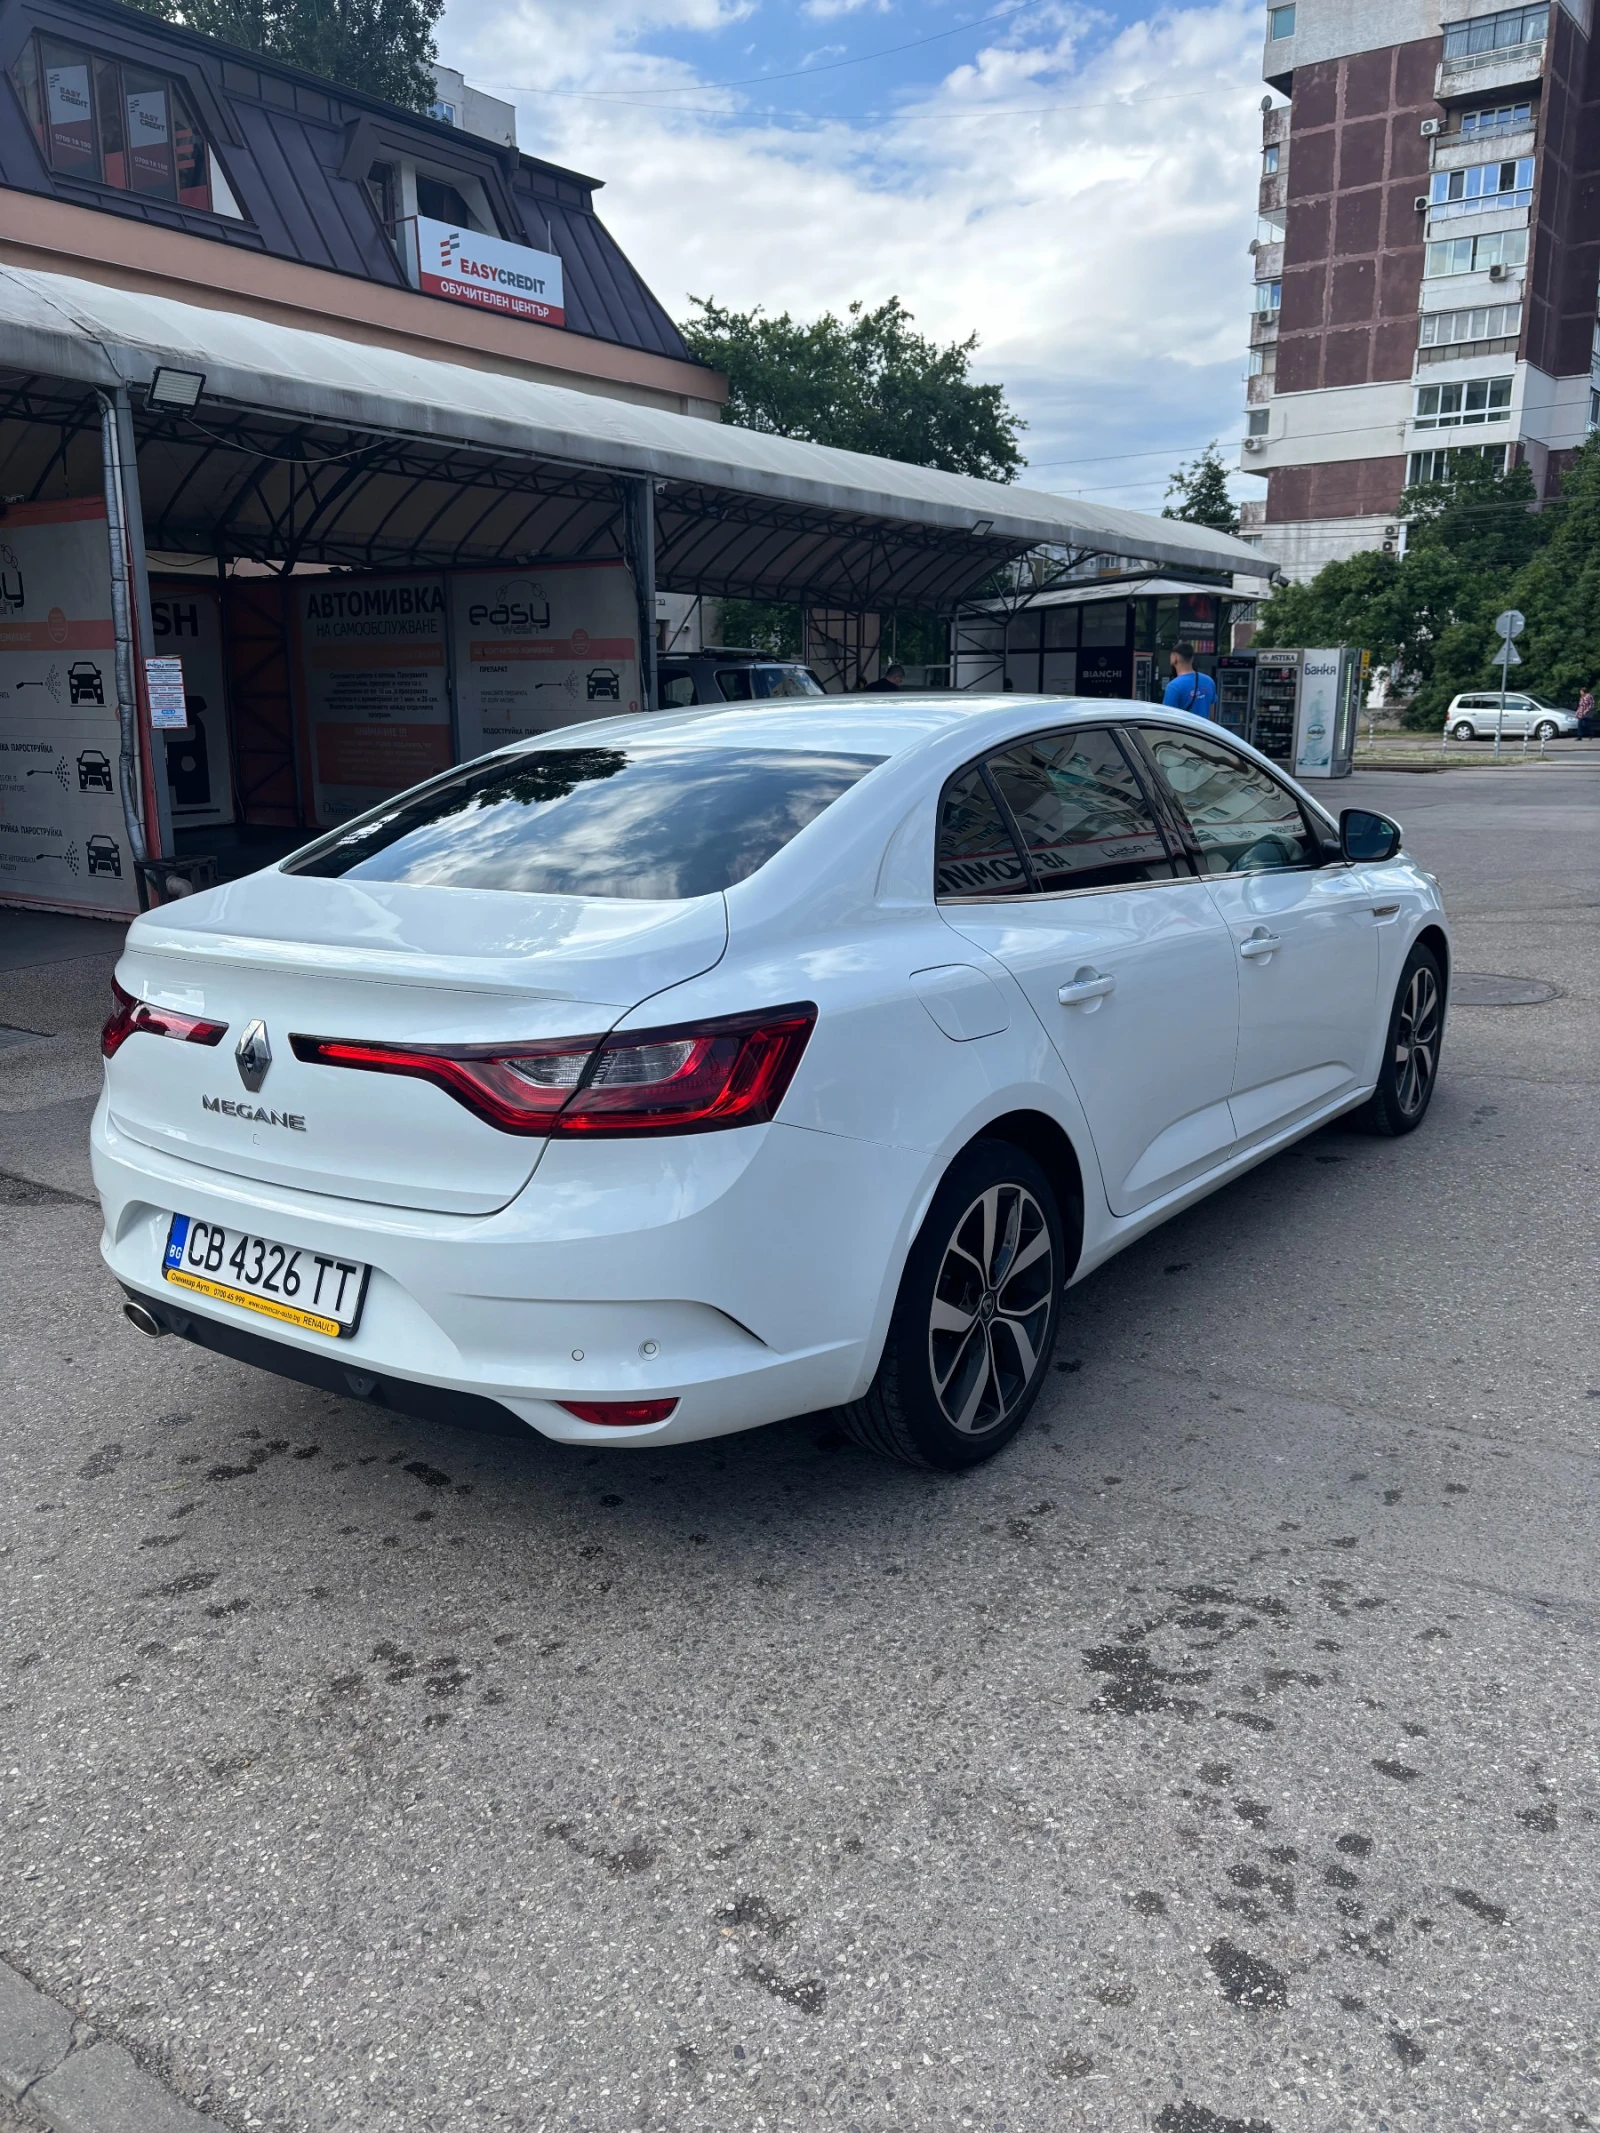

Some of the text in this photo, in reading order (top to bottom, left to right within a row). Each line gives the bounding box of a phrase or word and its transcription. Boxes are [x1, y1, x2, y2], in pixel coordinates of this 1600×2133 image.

[60, 87, 80, 98] EASY
[60, 94, 88, 108] CREDIT
[139, 111, 159, 122] EASY
[140, 118, 165, 132] CREDIT
[55, 133, 71, 143] 0700
[460, 257, 545, 294] EASYCREDIT
[440, 280, 549, 318] ОБУЧИТЕЛЕН ЦЕНТЪР
[307, 585, 446, 619] АВТОМИВКА
[468, 601, 550, 629] easy
[316, 618, 439, 637] НА САМООБСЛУЖВАНЕ
[479, 665, 508, 673] ПРЕПАРАТ
[1082, 670, 1122, 678] BIANCHI
[1304, 662, 1337, 676] Банкя
[483, 726, 523, 736] ВОДОСТРУЙКА
[11, 742, 53, 754] ПАРОСТРУЙКА
[21, 826, 63, 838] ПАРОСТРУЙКА
[202, 1094, 307, 1132] MEGANE
[169, 1247, 183, 1260] BG
[187, 1222, 357, 1312] CB 4326 TT
[196, 1281, 210, 1292] Ауто
[213, 1288, 227, 1299] 0700
[227, 1293, 234, 1301] 45
[235, 1295, 246, 1304] 999
[302, 1315, 335, 1333] RENAULT
